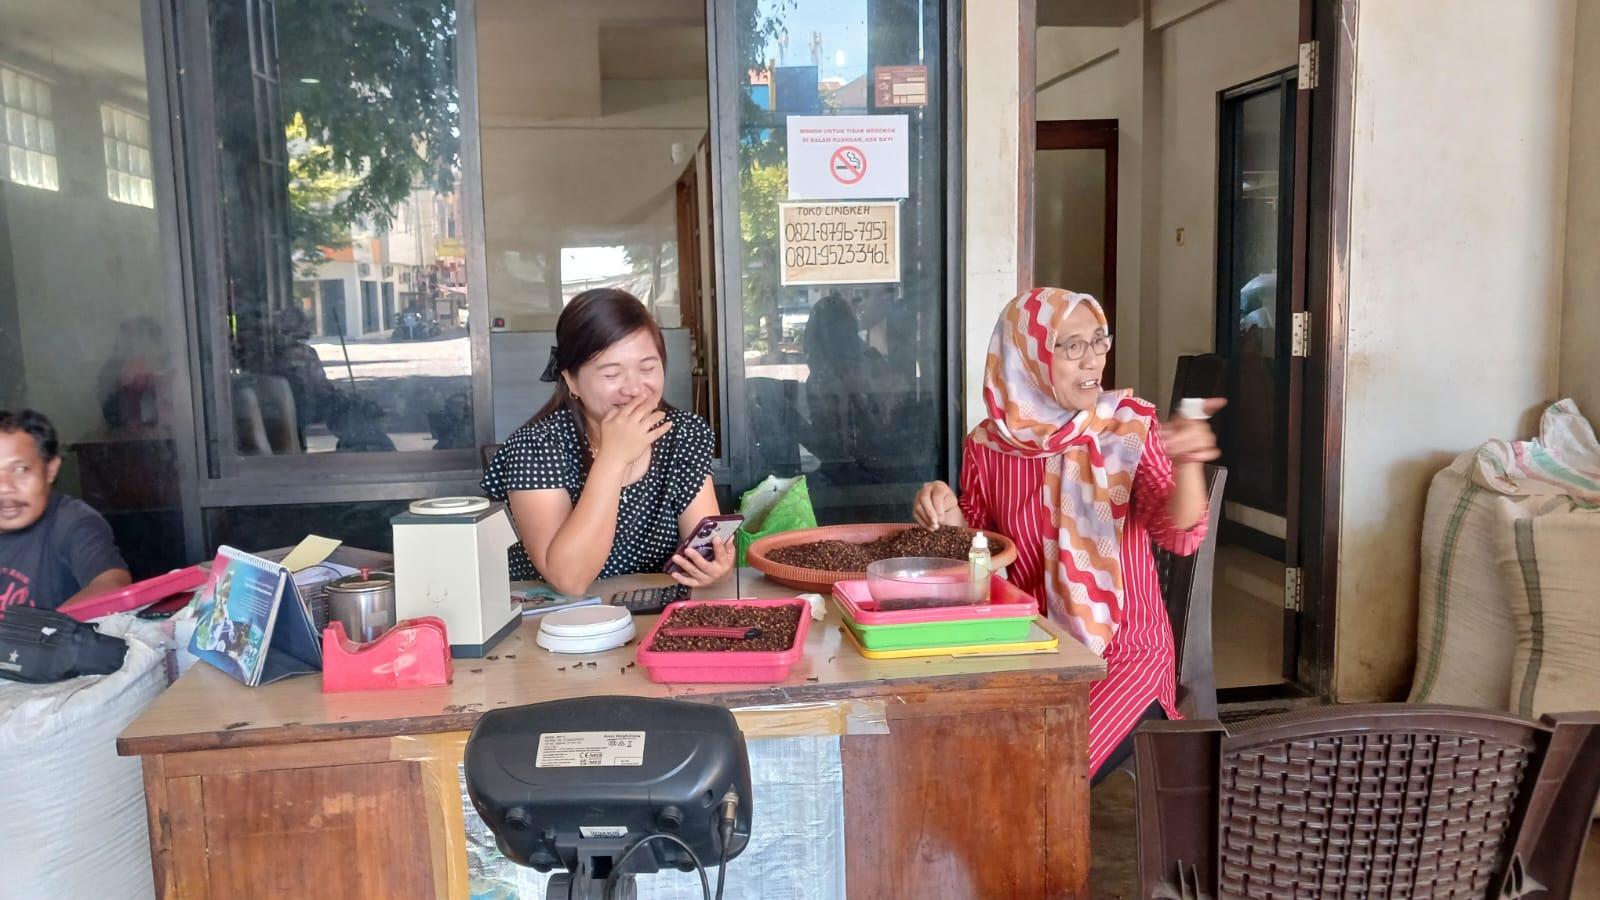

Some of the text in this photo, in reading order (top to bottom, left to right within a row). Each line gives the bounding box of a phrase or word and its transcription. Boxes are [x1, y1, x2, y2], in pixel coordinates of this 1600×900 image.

[797, 206, 871, 216] TOKO LINGKEH
[785, 221, 888, 242] 0821-8796-7951
